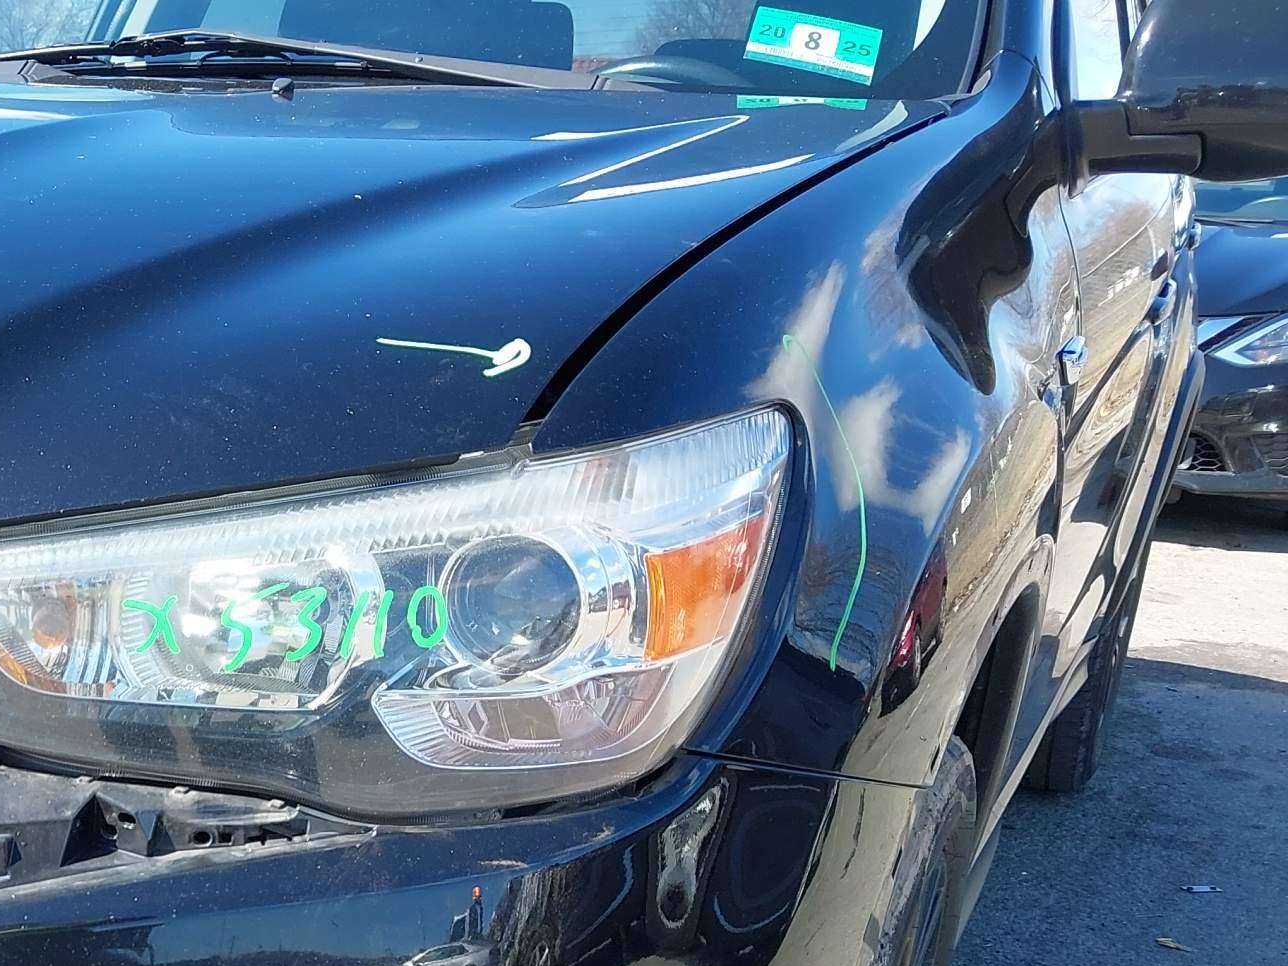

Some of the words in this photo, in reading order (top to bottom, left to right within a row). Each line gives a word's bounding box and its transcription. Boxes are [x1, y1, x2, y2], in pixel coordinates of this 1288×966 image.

[759, 24, 786, 39] 20
[804, 31, 822, 51] 8
[844, 40, 873, 57] 25
